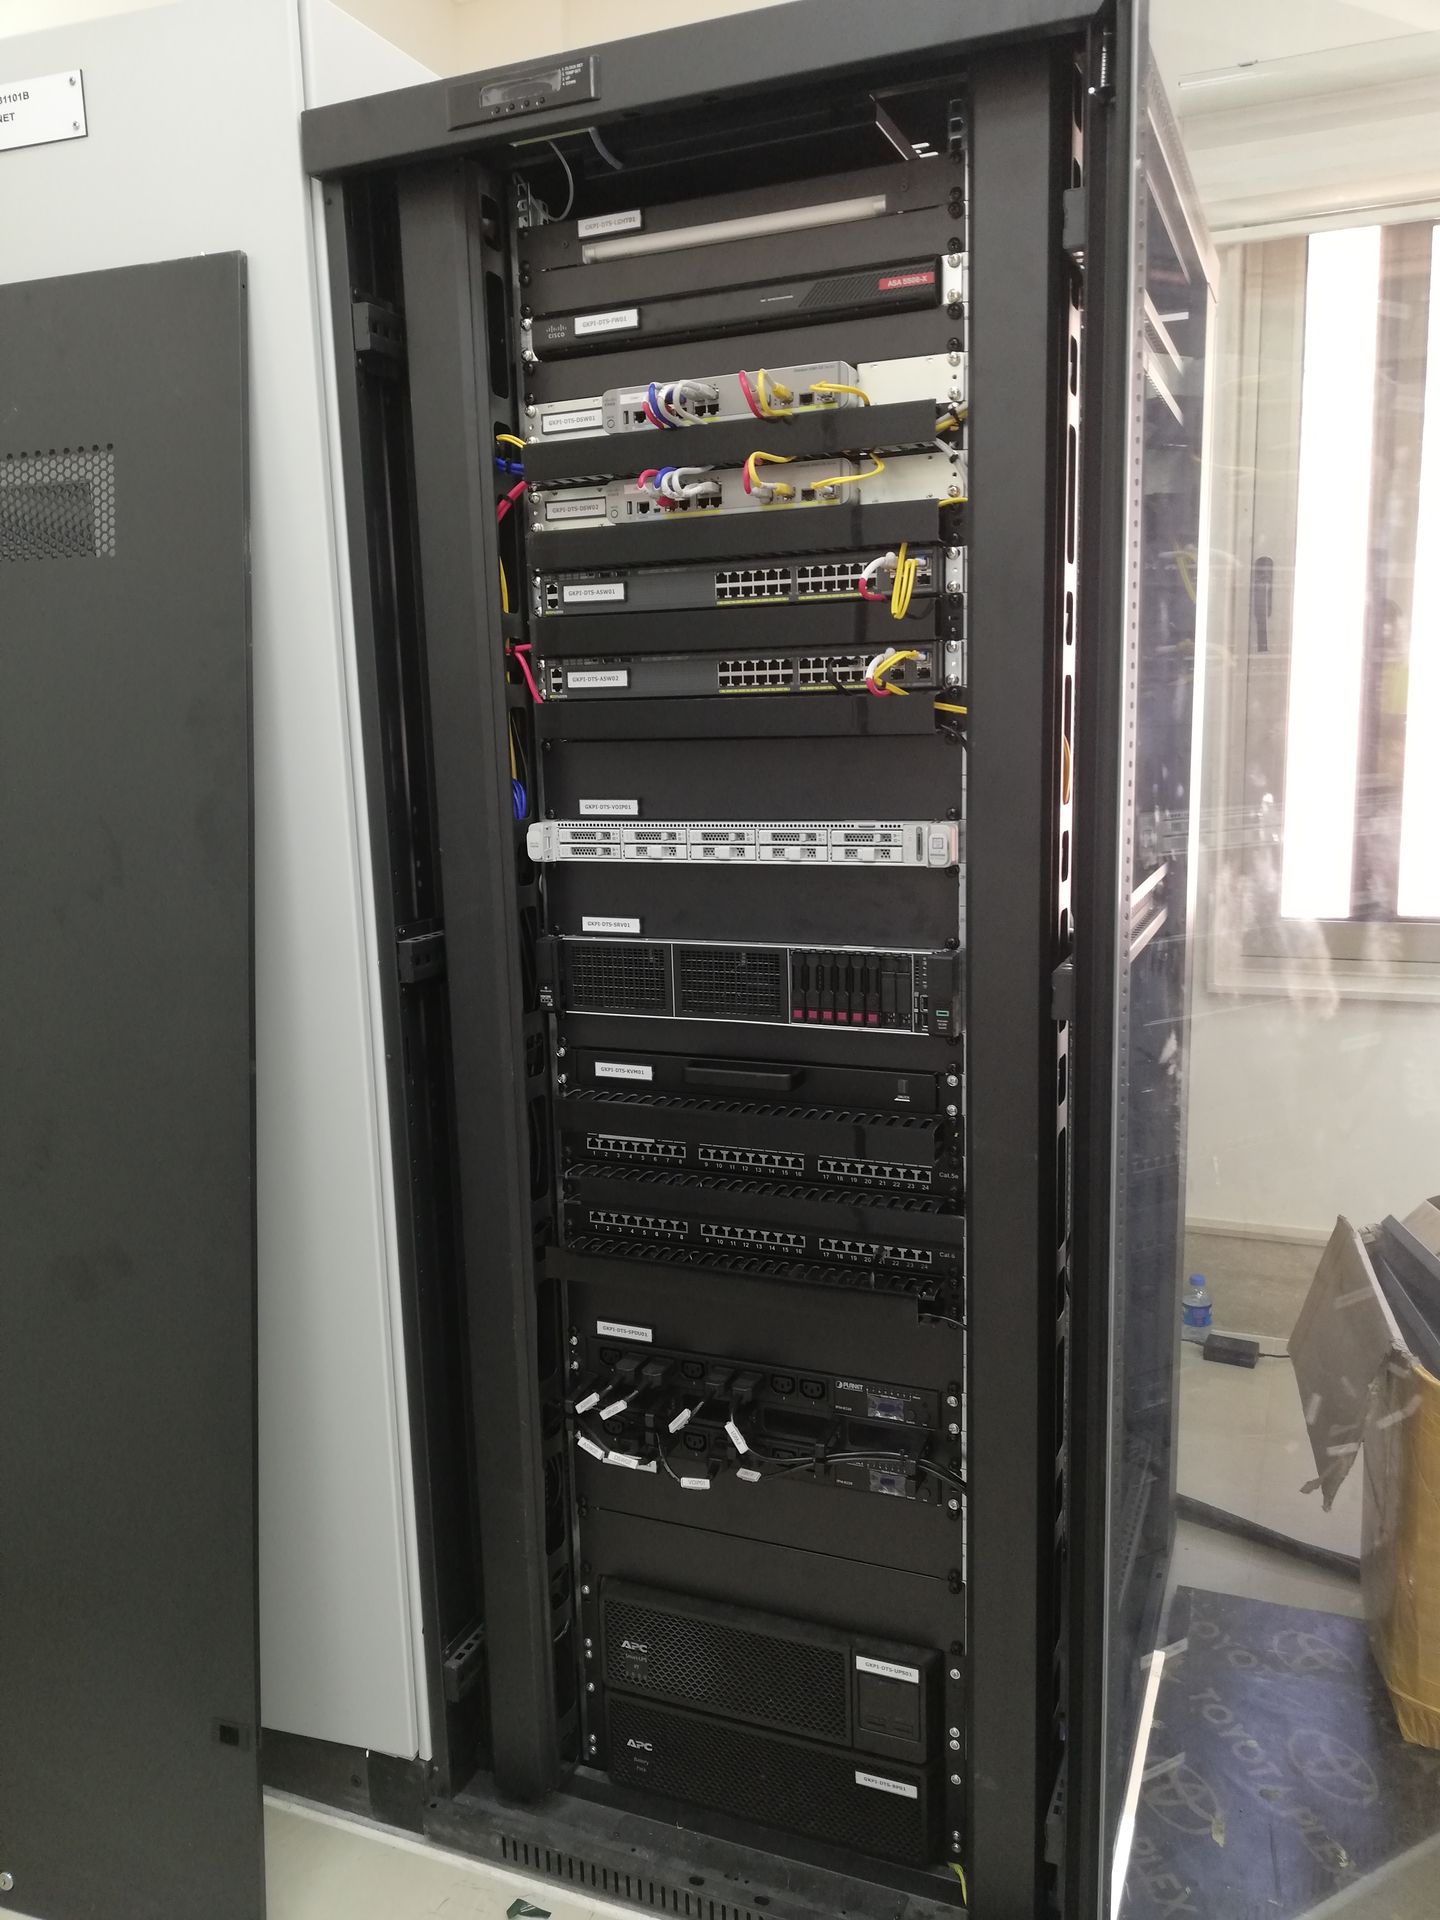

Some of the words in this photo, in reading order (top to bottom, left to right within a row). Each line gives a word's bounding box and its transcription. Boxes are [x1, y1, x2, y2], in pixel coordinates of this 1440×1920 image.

[887, 279, 902, 288] ASA
[621, 1640, 648, 1653] APC
[626, 1738, 653, 1752] APC
